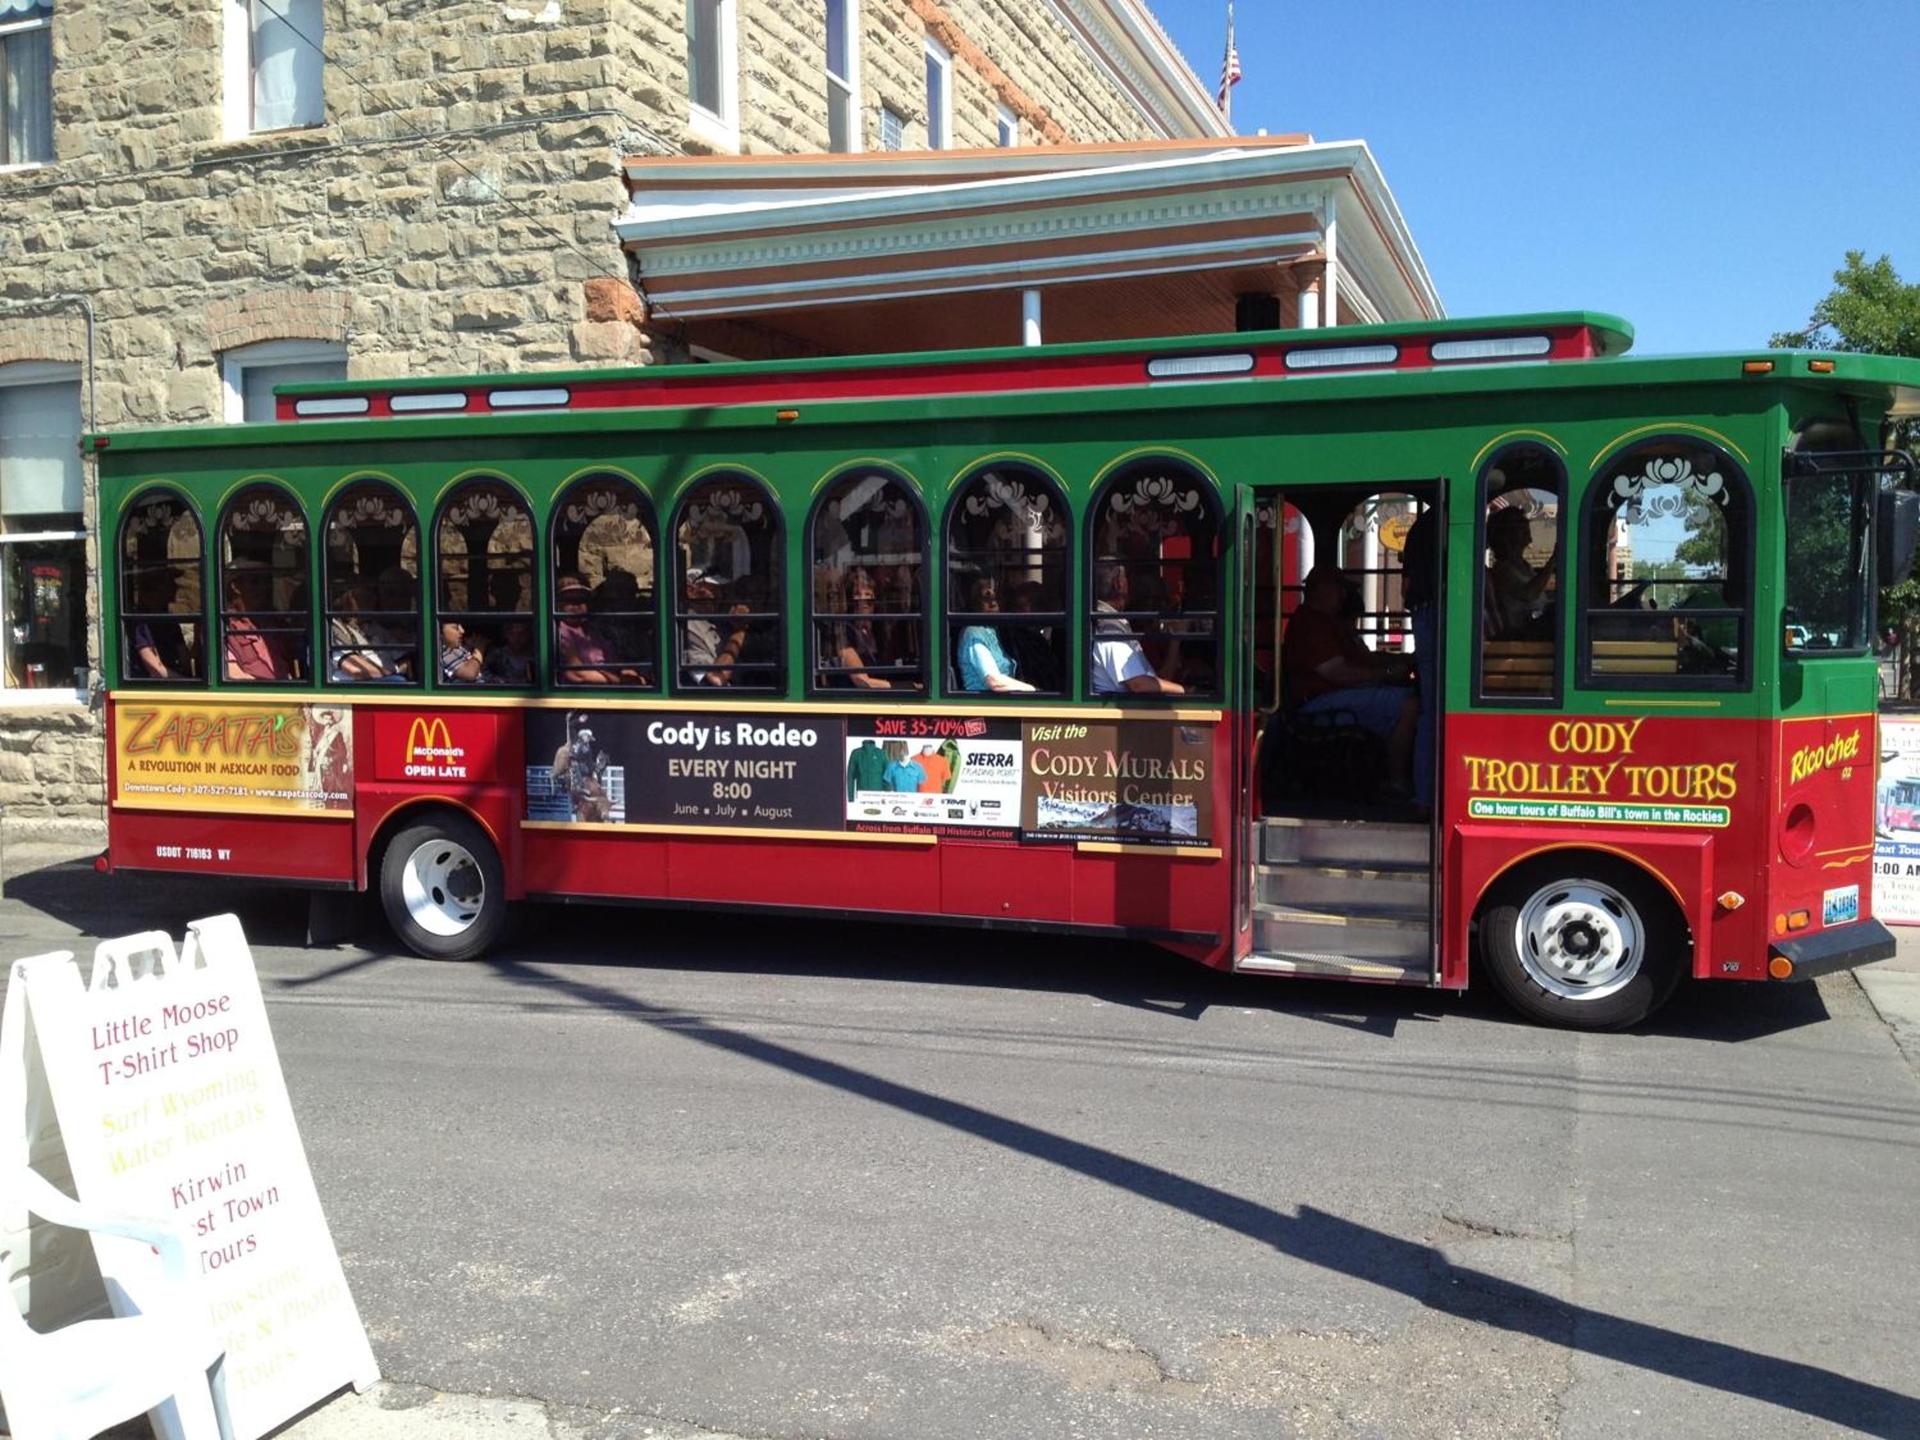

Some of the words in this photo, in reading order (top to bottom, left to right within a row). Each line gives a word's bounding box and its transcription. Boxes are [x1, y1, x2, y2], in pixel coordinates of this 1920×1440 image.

[125, 709, 302, 757] ZAPATA'S
[647, 721, 710, 750] Cody
[715, 725, 731, 745] is
[736, 722, 818, 747] Rodeo
[875, 718, 906, 735] SAVE
[1031, 726, 1061, 742] Visit
[1064, 724, 1087, 740] the
[1550, 716, 1647, 753] CODY
[128, 760, 136, 772] A
[140, 760, 201, 773] REVOLUTION
[206, 761, 216, 773] IN
[220, 762, 267, 776] MEXICAN
[272, 764, 300, 777] FOOD
[668, 759, 729, 778] EVERY
[735, 760, 797, 780] NIGHT
[966, 752, 1014, 767] SIERRA
[1031, 748, 1098, 778] CODY
[1105, 750, 1205, 781] MURALS
[405, 765, 436, 777] OPEN
[438, 766, 467, 778] LATE
[1463, 755, 1625, 796] TROLLEY
[1625, 761, 1738, 801] TOURS
[124, 782, 165, 794] Downtown
[167, 783, 187, 795] Cody
[712, 781, 752, 800] 8:00
[1043, 781, 1116, 804] Visitors
[1123, 782, 1194, 808] Center
[672, 802, 700, 816] June
[714, 802, 737, 819] July
[753, 804, 793, 820] August
[1474, 802, 1494, 814] One
[1496, 803, 1518, 815] hour
[1520, 804, 1546, 816] tours
[1547, 805, 1559, 816] of
[1561, 805, 1596, 818] Buffalo
[1597, 807, 1622, 819] Bill's
[1624, 808, 1650, 820] town
[1652, 808, 1662, 820] in
[1664, 808, 1681, 821] the
[1683, 809, 1724, 823] Rockies
[856, 823, 881, 833] Across
[882, 824, 901, 834] from
[903, 825, 932, 834] Buffalo
[933, 826, 945, 835] Bill
[947, 827, 984, 837] Historical
[986, 828, 1013, 838] Center
[218, 849, 231, 861] WY
[92, 1015, 152, 1050] Little
[162, 995, 231, 1030] Moose
[98, 1042, 178, 1085] T-Shirt
[187, 1028, 239, 1058] Shop
[171, 1162, 247, 1209] Kirwin
[223, 1186, 280, 1223] Town
